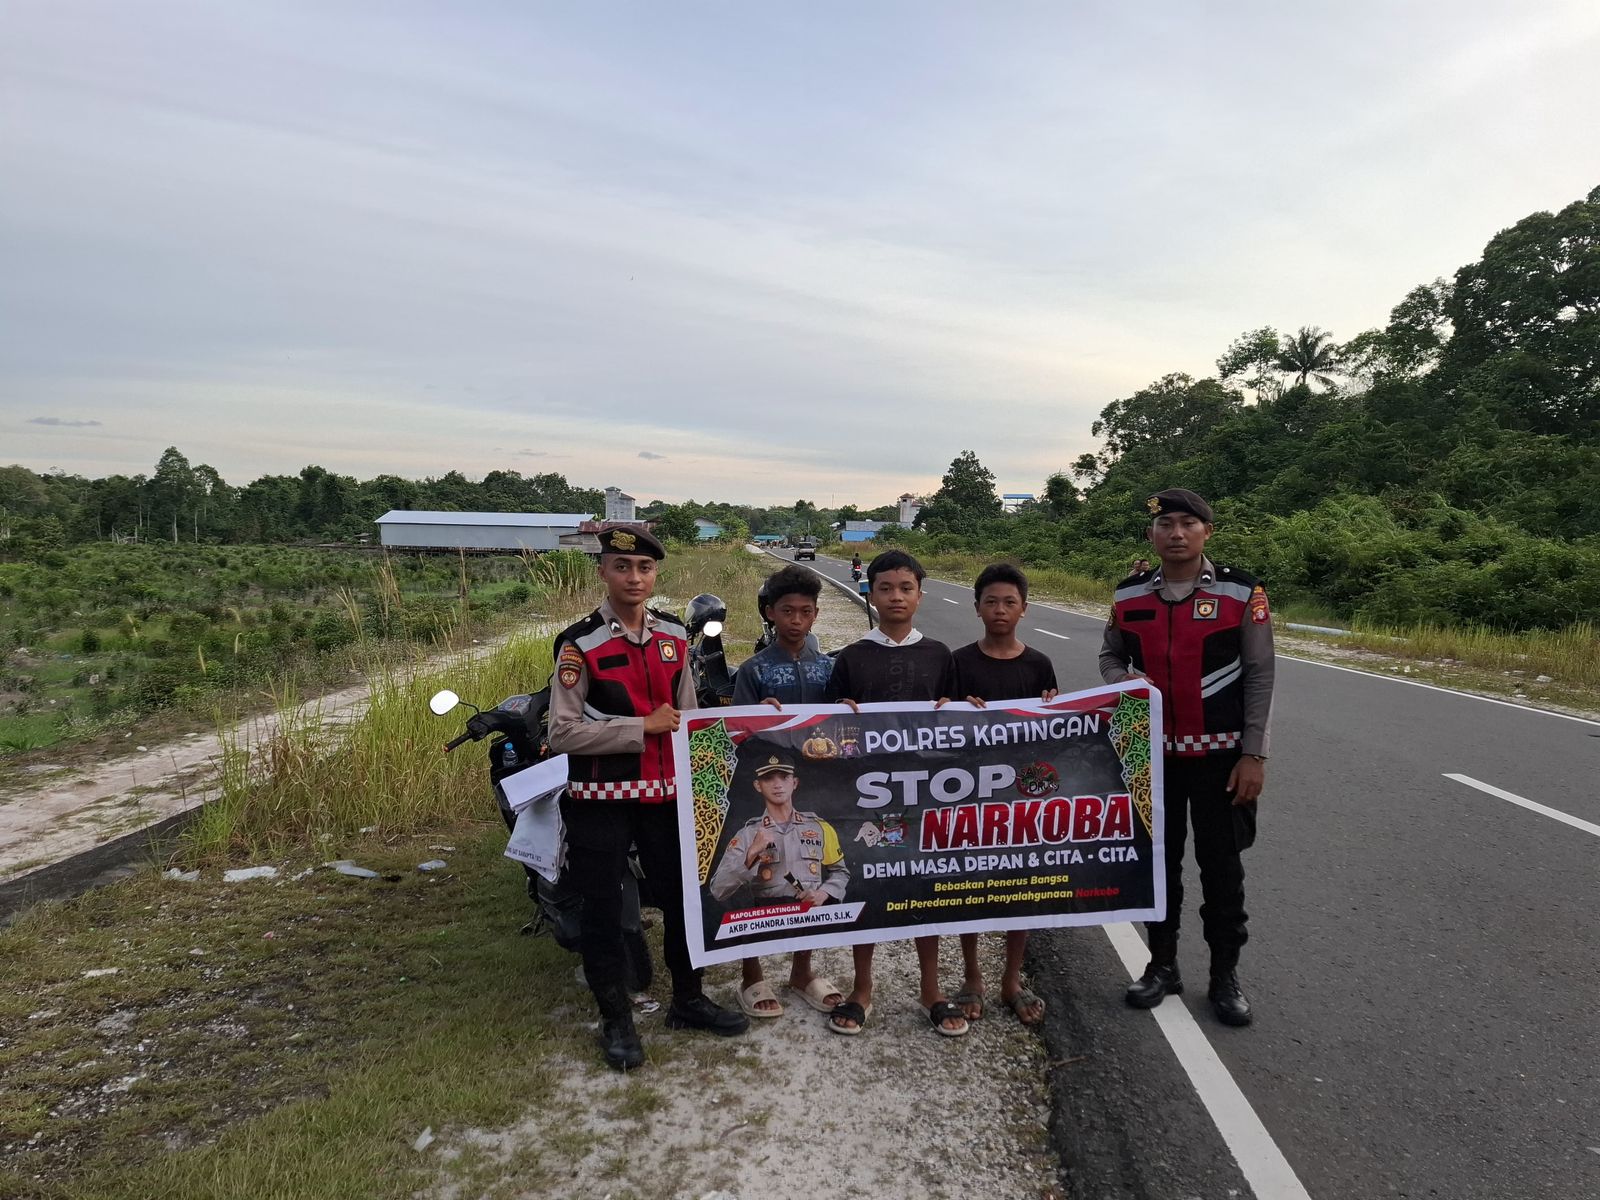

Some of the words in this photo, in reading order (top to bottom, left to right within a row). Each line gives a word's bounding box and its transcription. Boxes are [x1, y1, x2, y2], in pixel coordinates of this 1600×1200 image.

[865, 726, 966, 753] POLRES
[973, 714, 1100, 747] KATINGAN
[855, 764, 1016, 809] STOP
[919, 793, 1134, 852] NARKOBA
[800, 839, 822, 847] POLRI
[863, 861, 906, 879] DEMI
[911, 857, 960, 876] MASA
[964, 853, 1024, 872] DEPAN
[1027, 852, 1040, 868] &
[1043, 849, 1084, 866] CITA
[1098, 846, 1139, 863] CITA
[934, 880, 984, 892] Bebaskan
[987, 876, 1028, 888] Penerus
[1030, 874, 1069, 886] Bangsa
[886, 899, 908, 912] Dari
[910, 897, 962, 909] Peredaran
[965, 895, 985, 905] dan
[987, 889, 1073, 904] Penyalahgunaan
[1075, 886, 1120, 898] Narkoba
[728, 923, 748, 934] AKBP
[750, 918, 785, 930] CHANDRA
[786, 913, 833, 926] ISMAWANTO,
[833, 911, 853, 920] S.I.K.
[730, 909, 765, 920] KAPOLRES
[766, 905, 801, 915] KATINGAN
